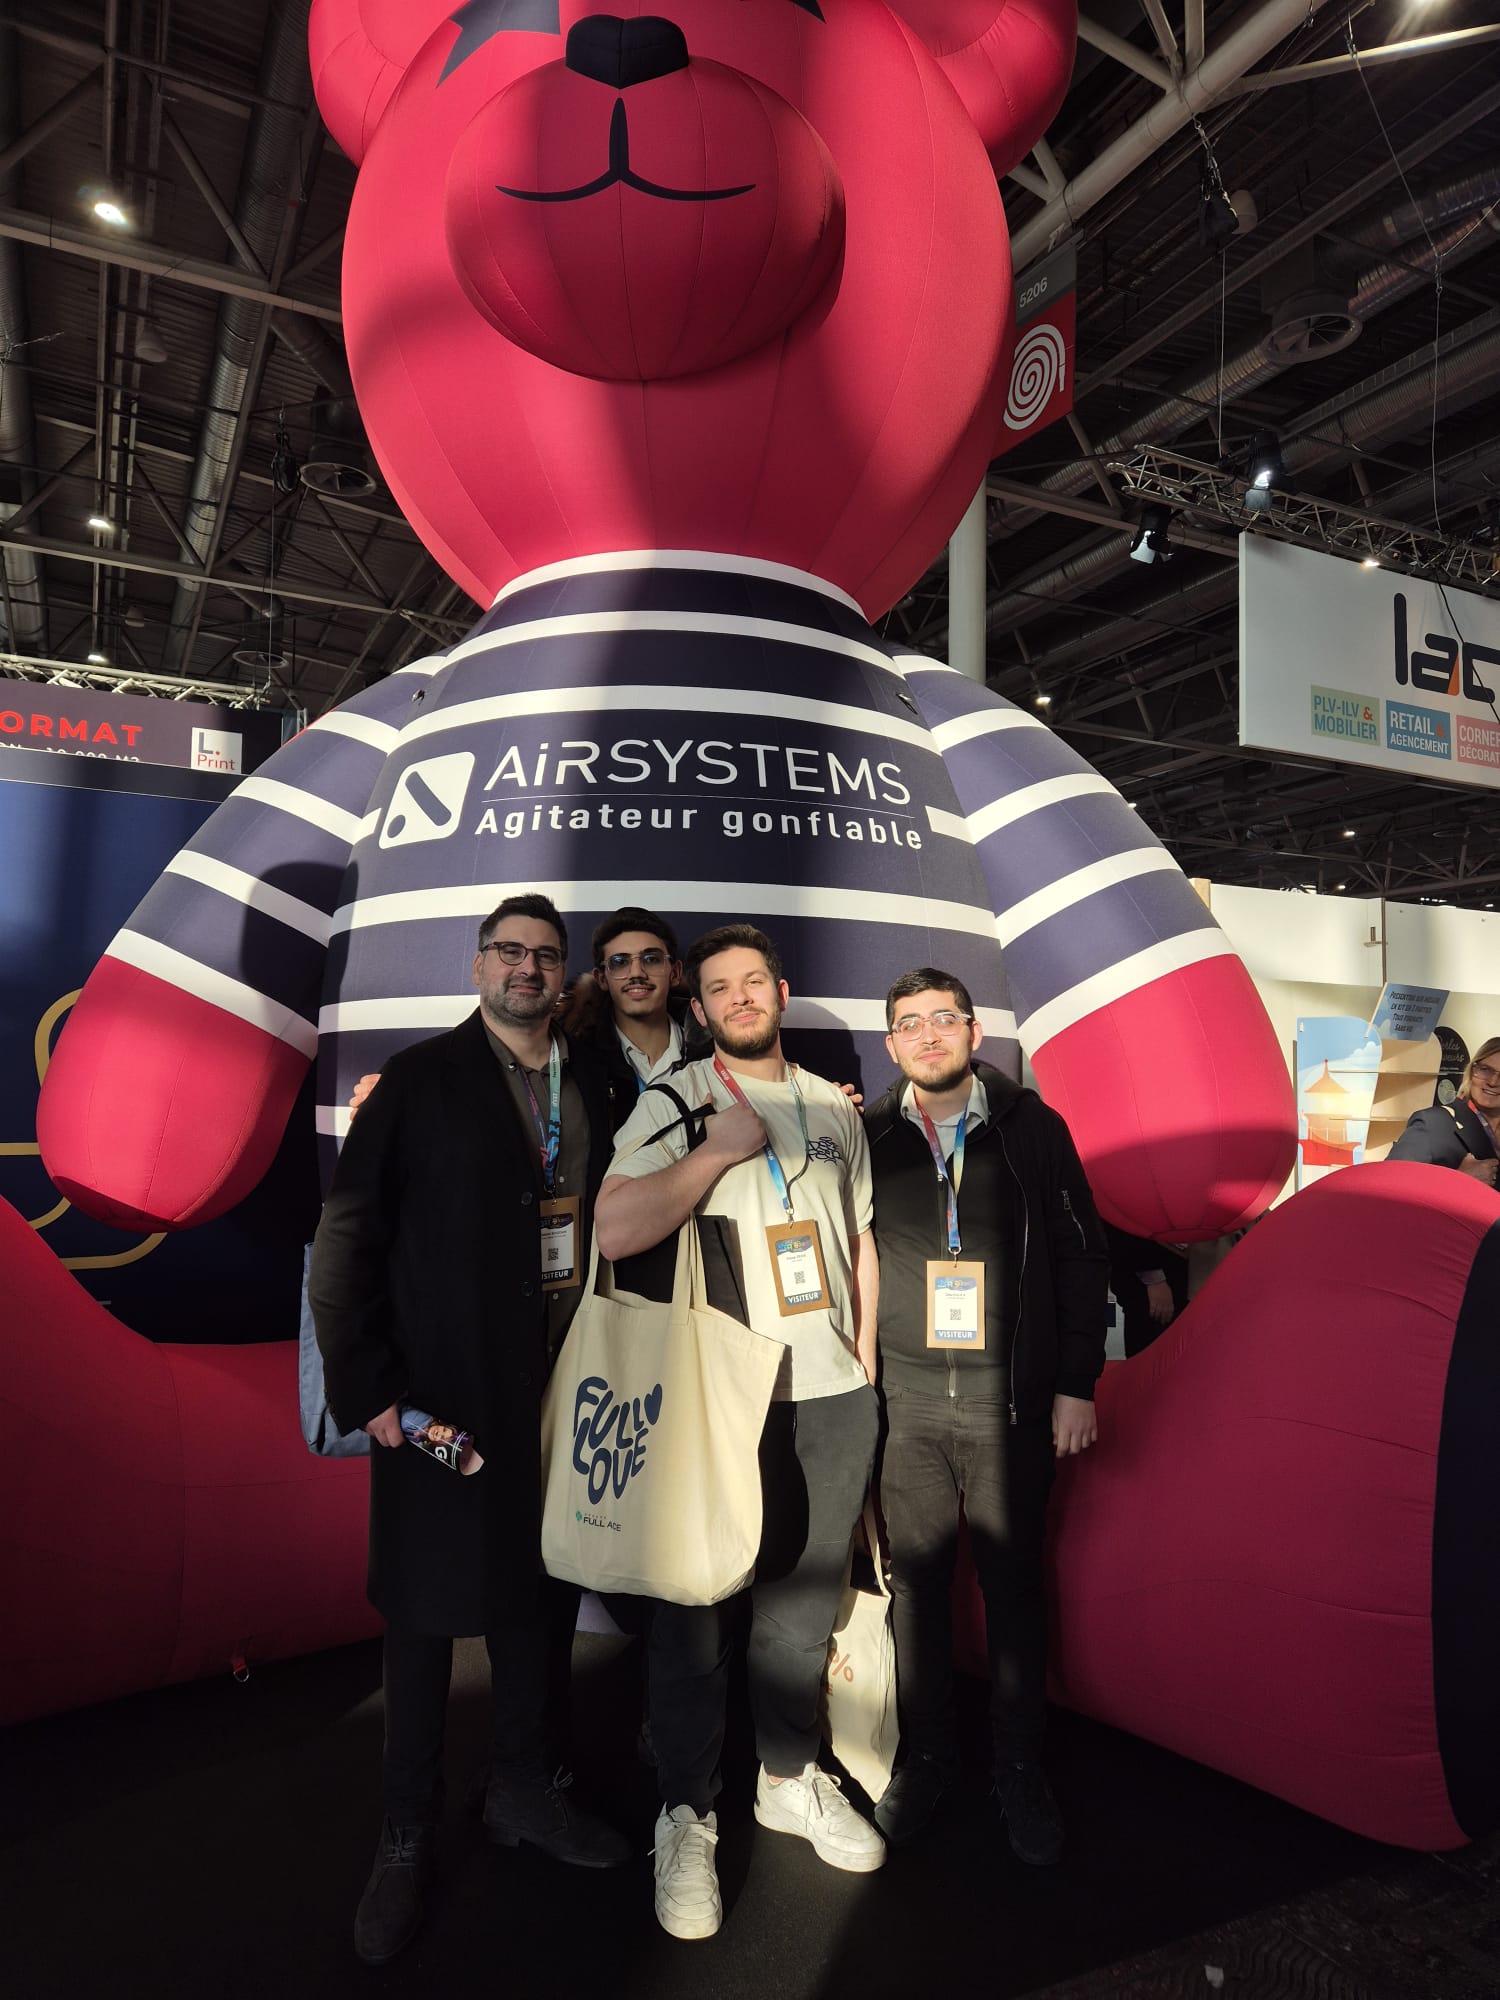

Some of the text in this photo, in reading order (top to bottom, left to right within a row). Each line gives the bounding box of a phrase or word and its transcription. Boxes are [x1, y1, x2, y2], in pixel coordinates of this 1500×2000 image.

[1019, 277, 1048, 308] 5206
[1314, 695, 1374, 721] PLV-ILV &
[1314, 713, 1377, 740] MOBILIER
[1390, 710, 1435, 736] RETAIL
[1390, 732, 1449, 754] AGENCEMENT
[197, 753, 235, 770] Print
[474, 803, 922, 849] Agitateur gonflable
[541, 1270, 569, 1280] ISITEUR
[788, 1291, 819, 1304] VISITEUR
[938, 1330, 973, 1339] VISITEUR
[573, 1376, 645, 1450] FULL
[572, 1417, 650, 1505] LOVE
[583, 1516, 606, 1528] FULL
